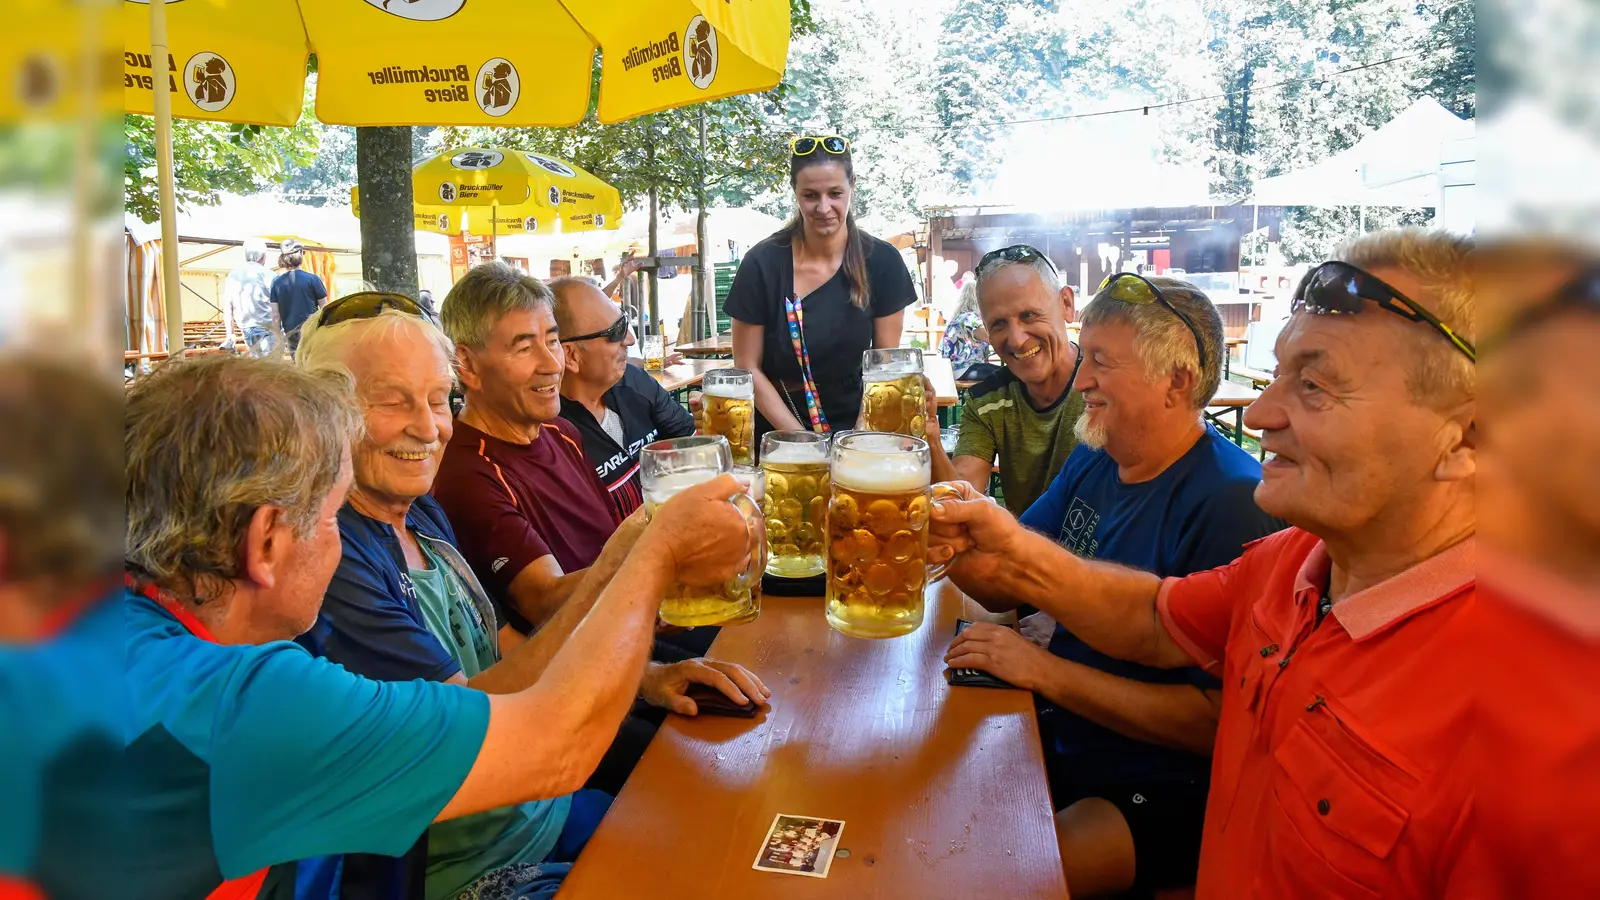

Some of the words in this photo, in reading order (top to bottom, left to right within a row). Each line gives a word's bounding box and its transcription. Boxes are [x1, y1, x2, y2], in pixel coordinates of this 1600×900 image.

[595, 451, 629, 479] EARL
[1076, 538, 1088, 556] our
[1084, 513, 1101, 539] 2015
[1087, 539, 1099, 559] ung
